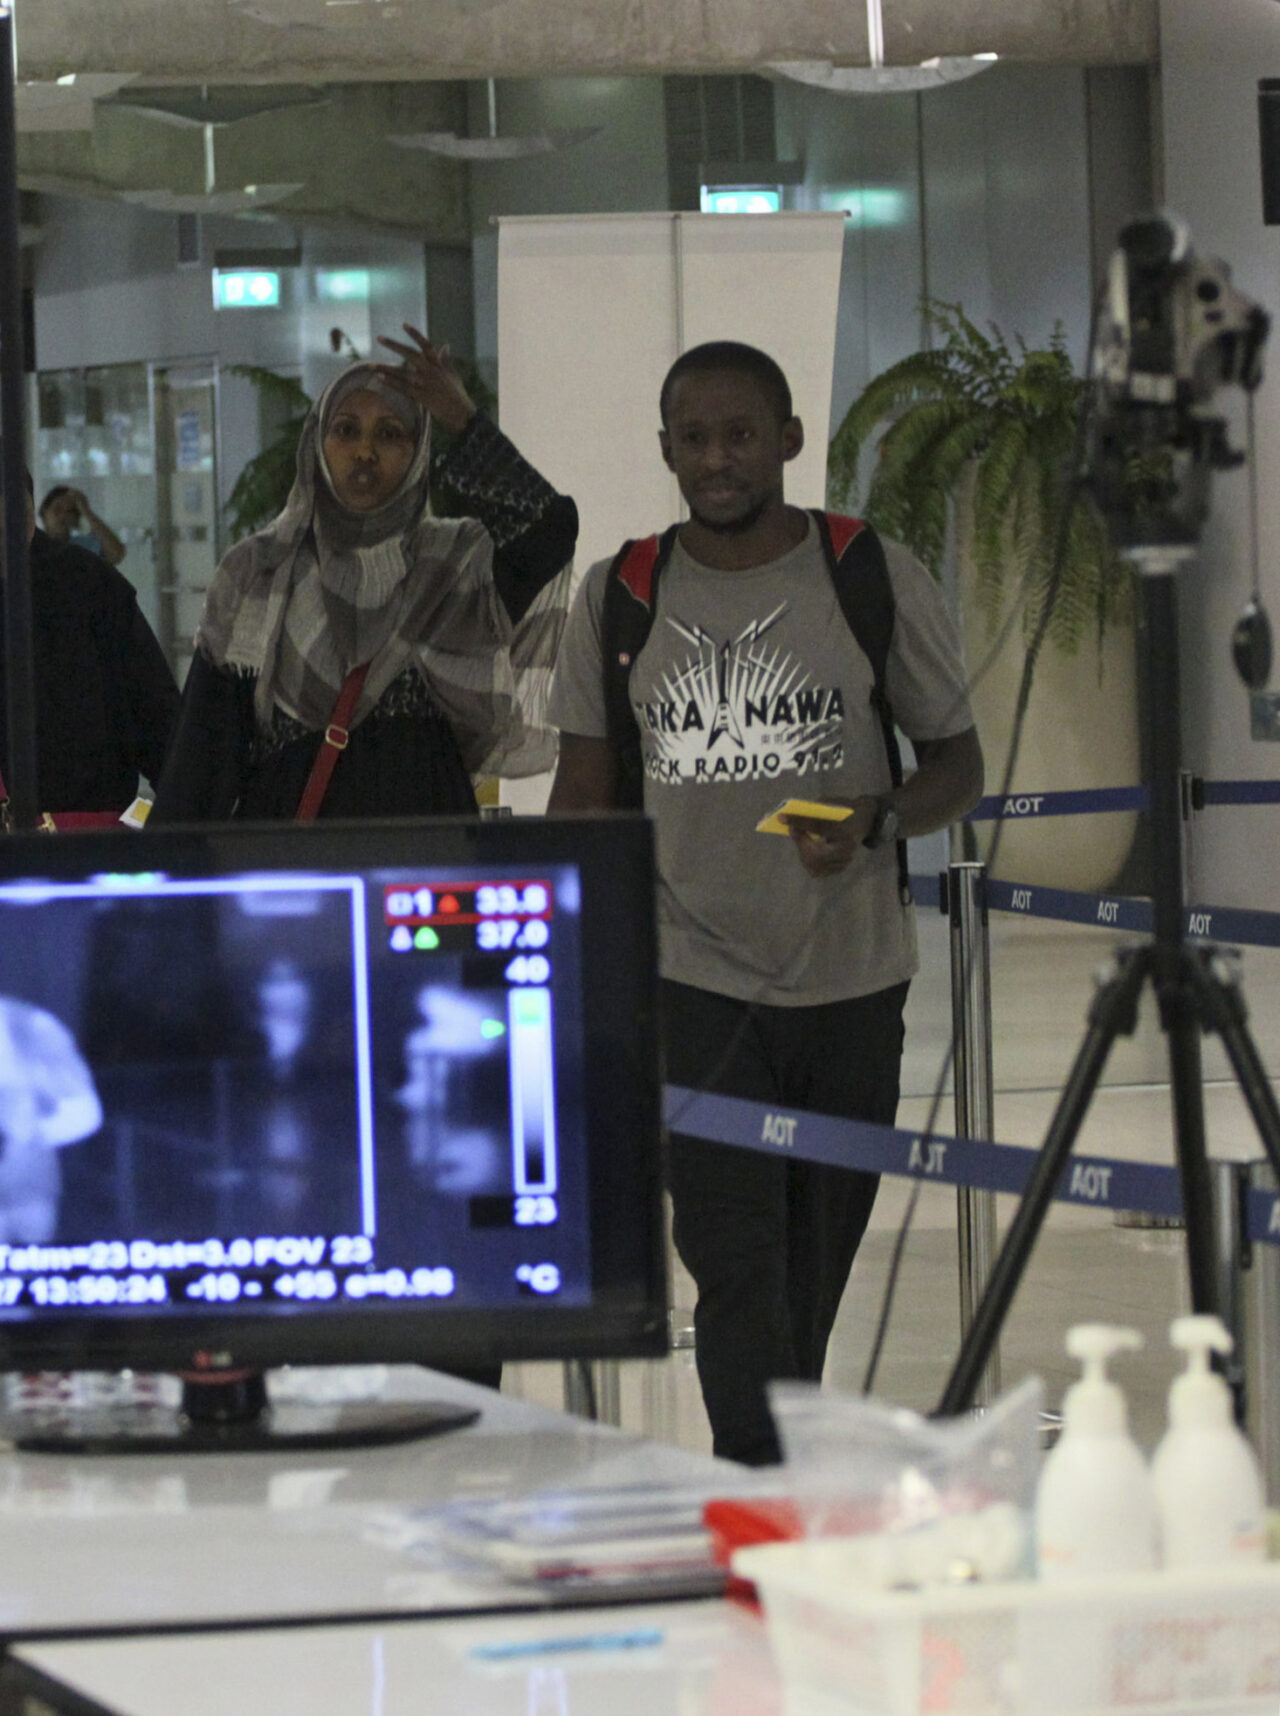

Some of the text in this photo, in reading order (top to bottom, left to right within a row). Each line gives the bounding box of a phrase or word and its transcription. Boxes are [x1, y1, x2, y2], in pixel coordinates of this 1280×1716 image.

[637, 688, 844, 733] AKA NAWA
[644, 752, 681, 777] OCK
[695, 752, 780, 776] RADIO
[1003, 797, 1044, 815] AOT
[1011, 890, 1212, 935] AOT AOT AOT
[762, 1114, 797, 1147] AOT
[1071, 1163, 1112, 1200] AOT
